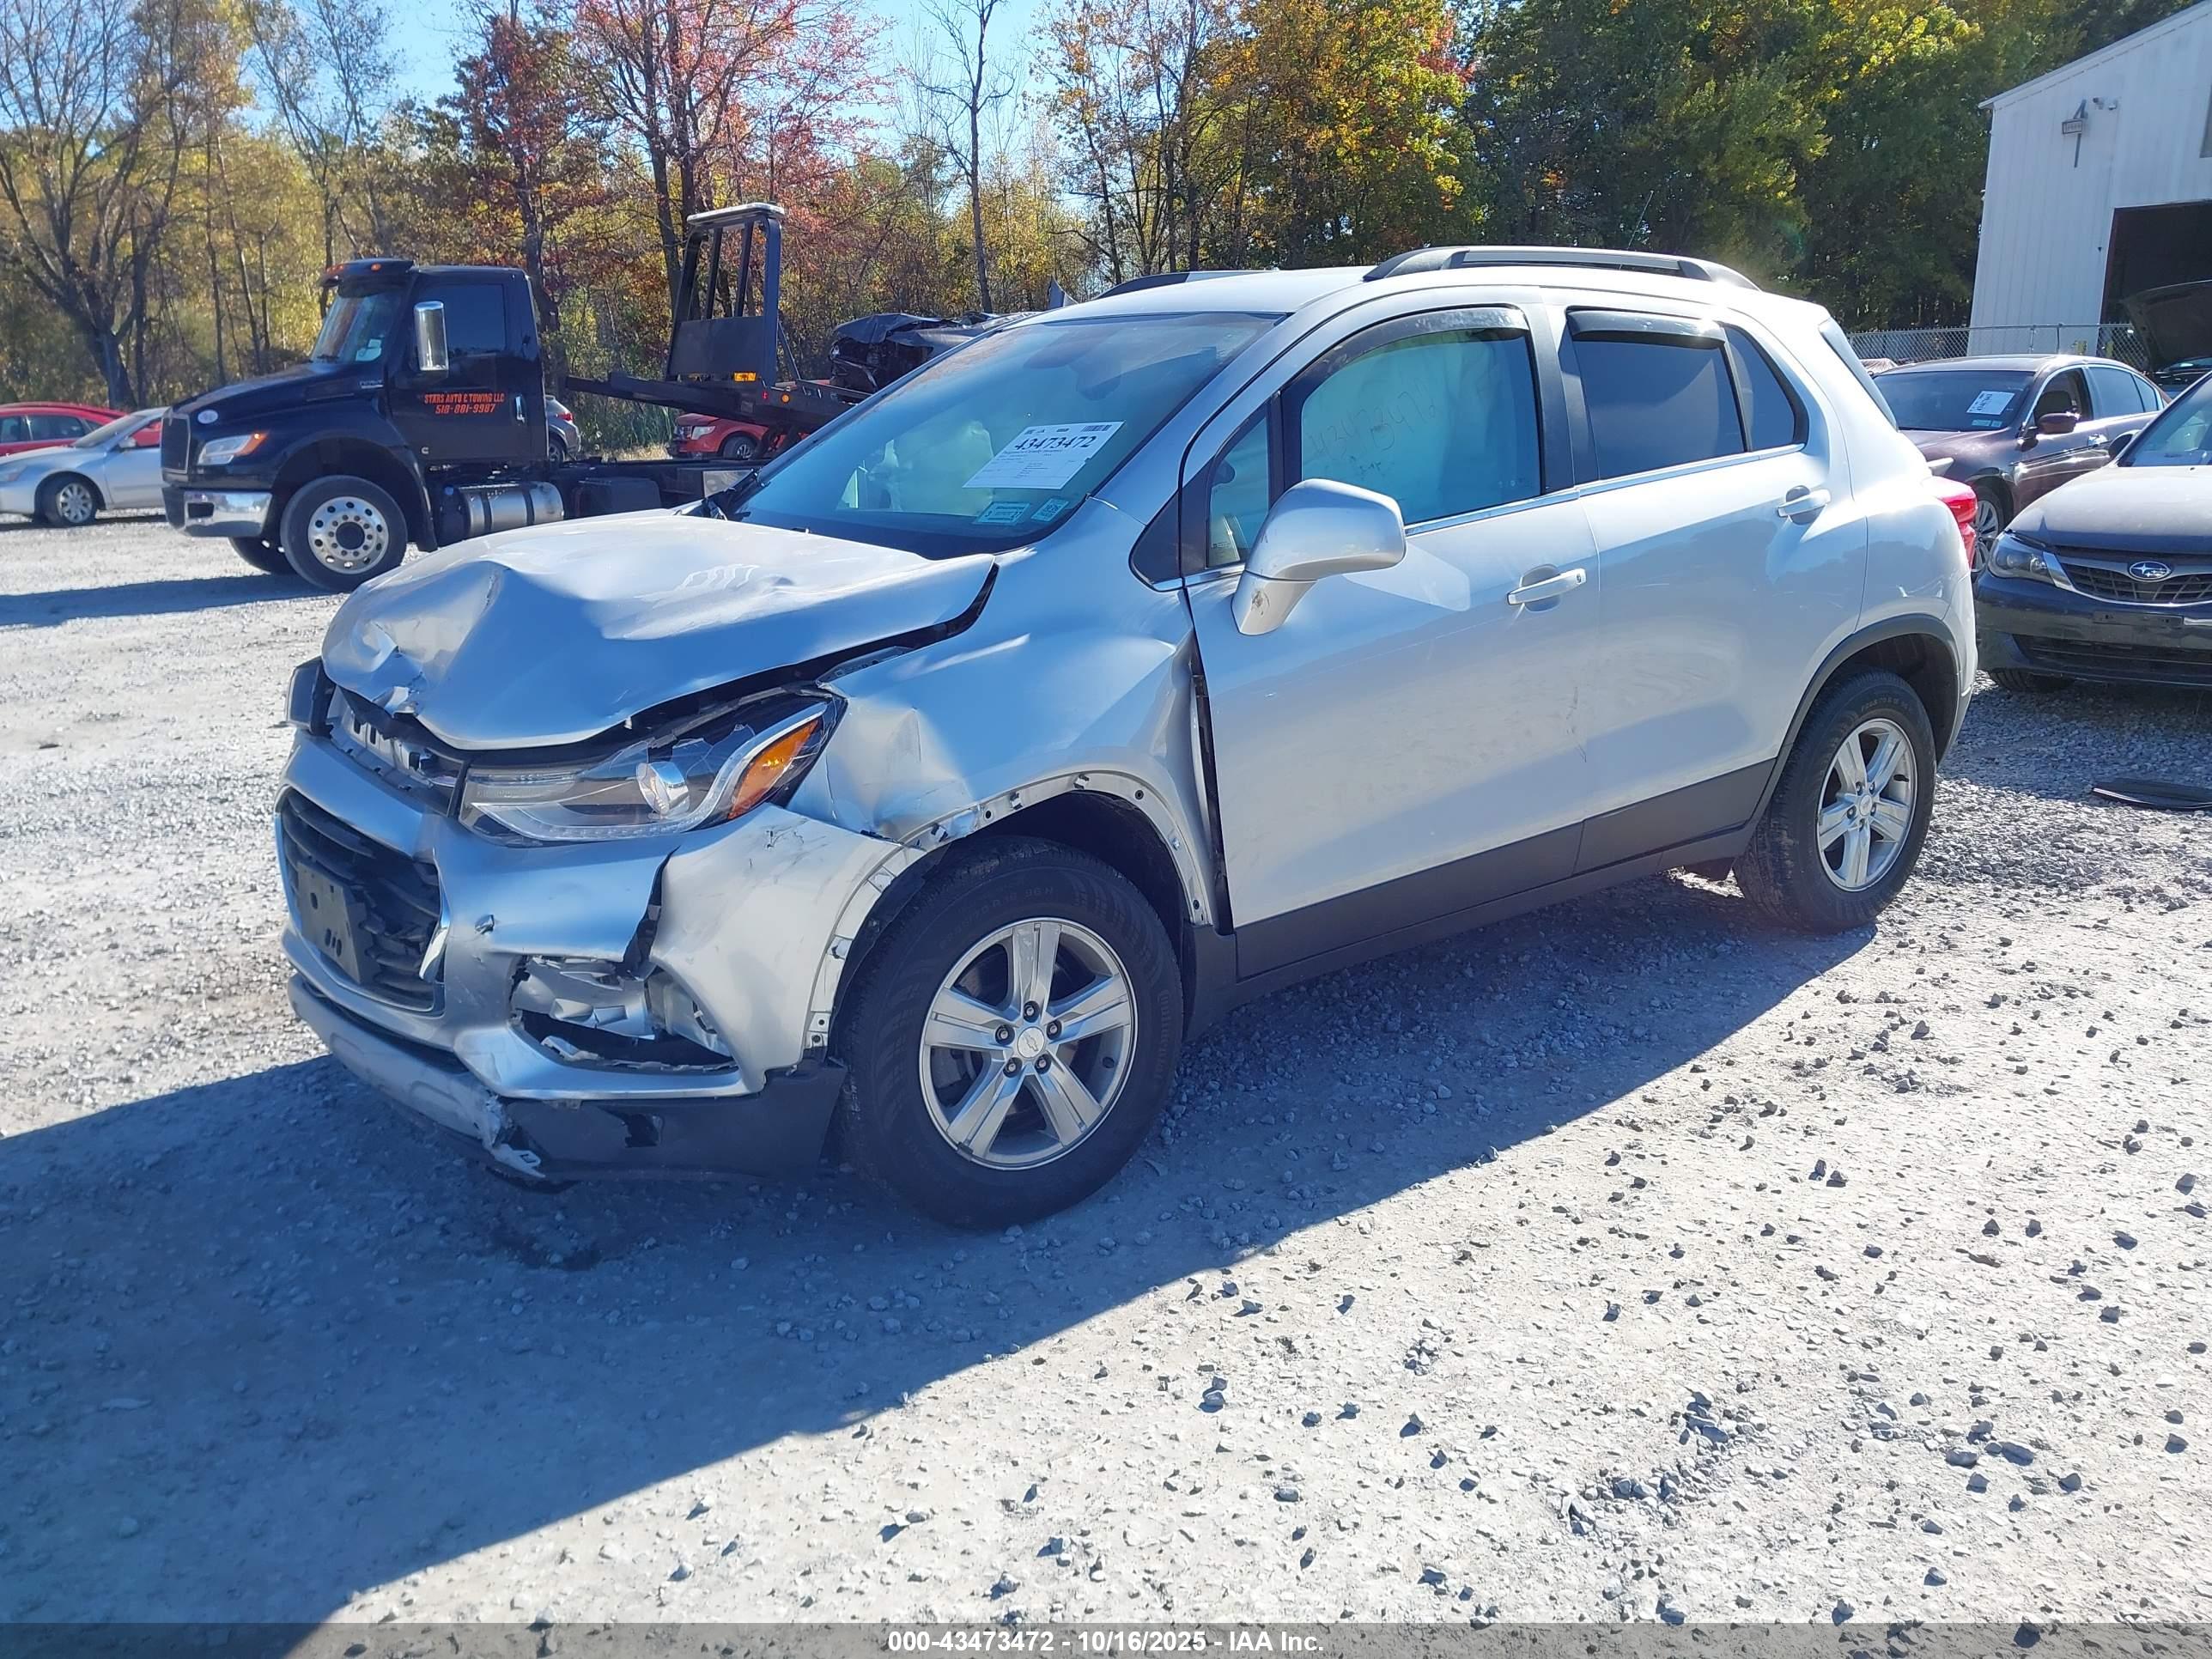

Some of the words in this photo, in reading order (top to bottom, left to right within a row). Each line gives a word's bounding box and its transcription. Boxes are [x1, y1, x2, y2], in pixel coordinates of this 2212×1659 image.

[445, 393, 462, 404] AUTO
[469, 392, 493, 403] TOWING
[493, 392, 505, 403] LLC
[1016, 435, 1097, 450] 43473472
